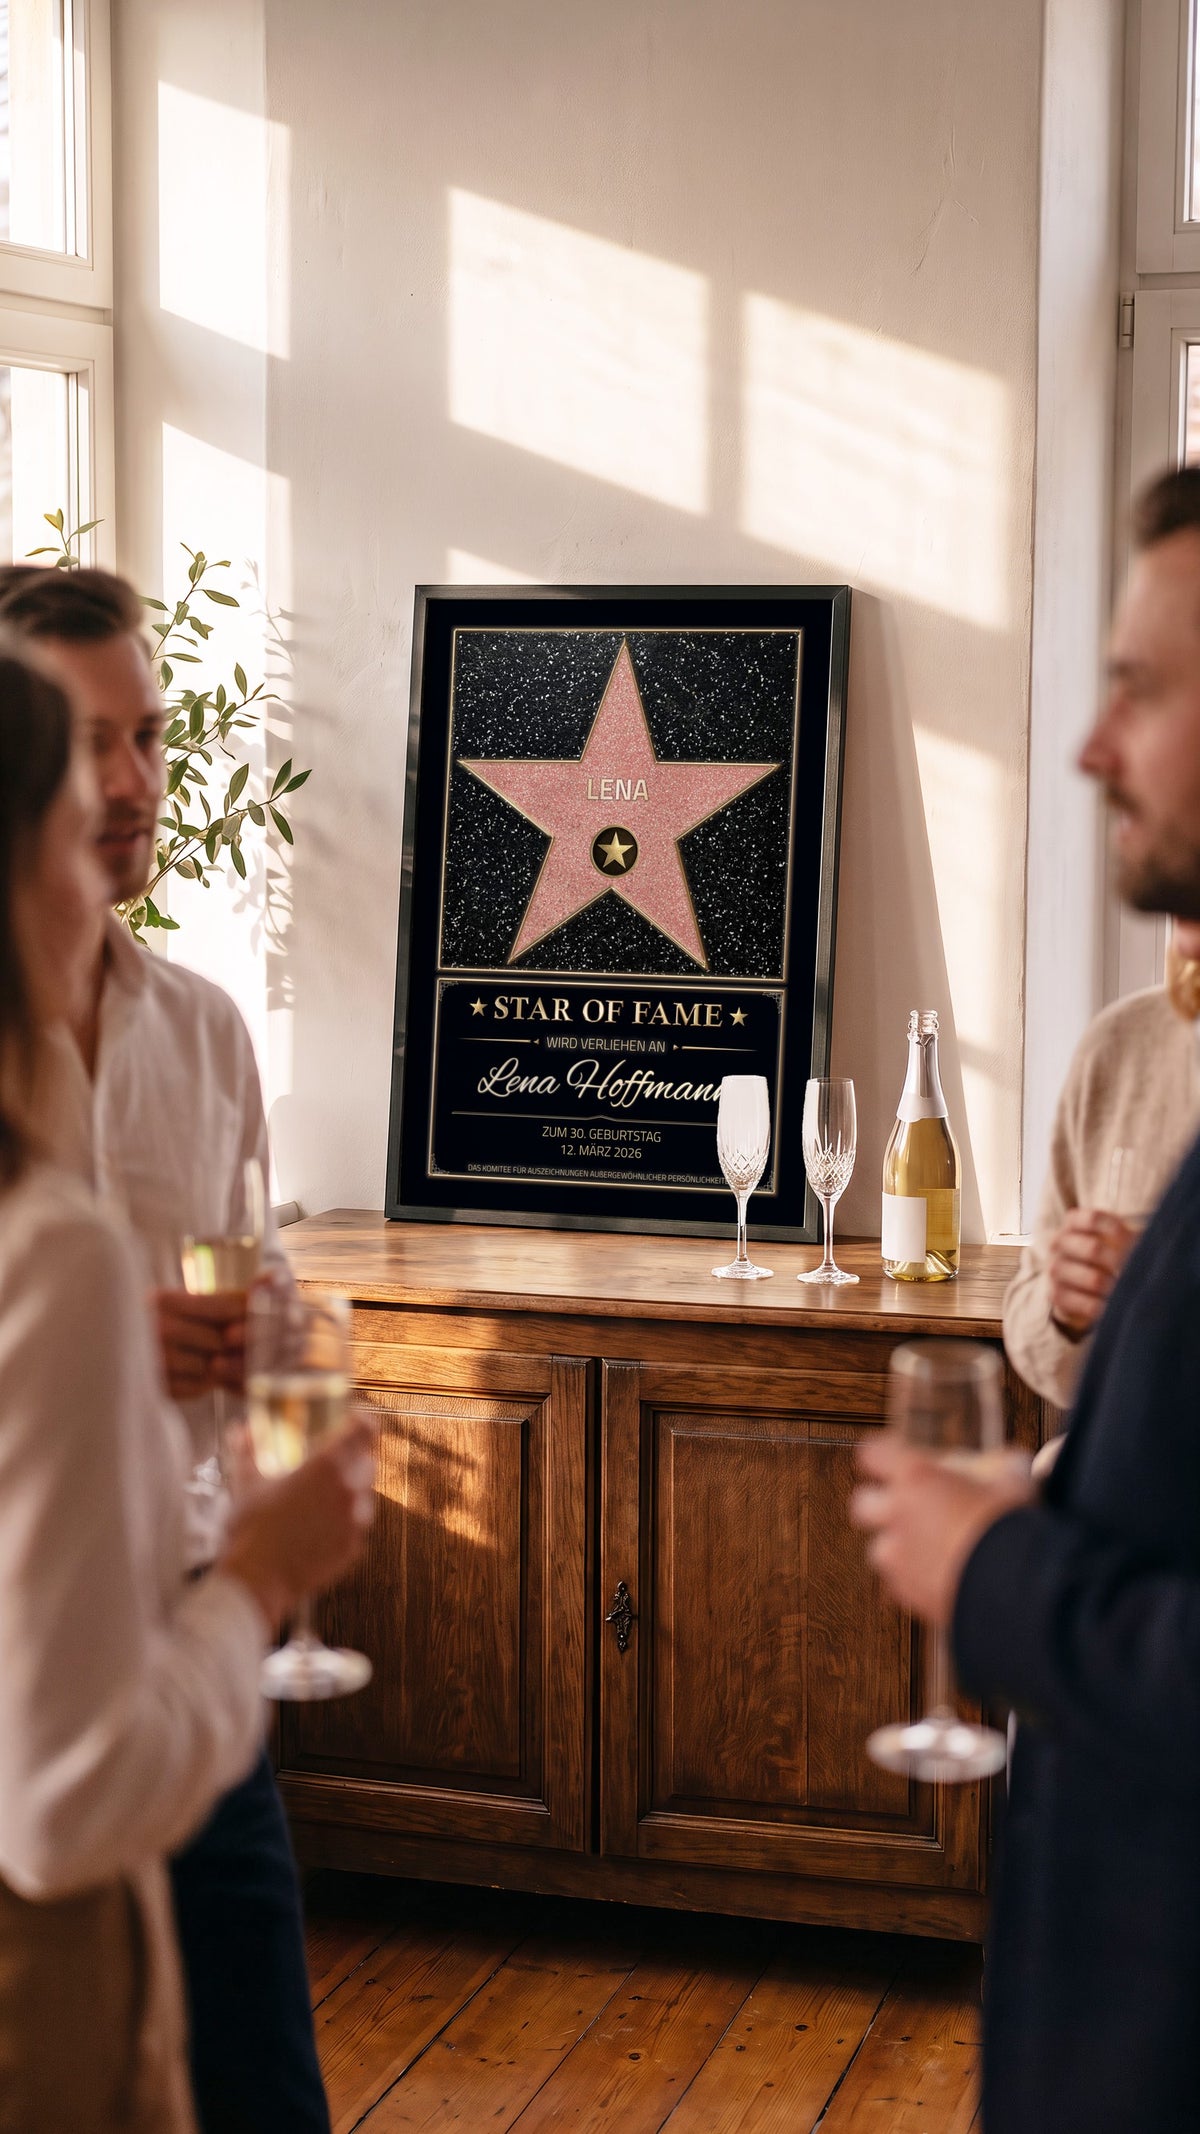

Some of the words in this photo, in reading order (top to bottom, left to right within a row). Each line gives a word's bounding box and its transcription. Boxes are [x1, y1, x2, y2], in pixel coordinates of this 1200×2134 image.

[587, 778, 649, 801] LENA
[493, 995, 574, 1022] STAR
[582, 998, 624, 1024] OF
[632, 1000, 723, 1028] FAME
[546, 1036, 578, 1049] WIRD
[580, 1037, 646, 1052] VERLIEHEN
[648, 1040, 666, 1053] AN
[477, 1057, 560, 1098] Lena
[541, 1126, 568, 1138] ZUM
[569, 1127, 587, 1139] 30.
[589, 1128, 661, 1143] GEBURTSTAG
[560, 1144, 576, 1156] 12.
[579, 1142, 612, 1157] MÄRZ
[614, 1146, 642, 1159] 2026
[467, 1163, 481, 1172] DAS
[482, 1164, 512, 1174] KOMITEE
[512, 1164, 527, 1174] FÜR
[527, 1167, 589, 1178] AUSZEICHNUNGEN
[667, 1173, 729, 1185] PERSÖNLICHKEITE
